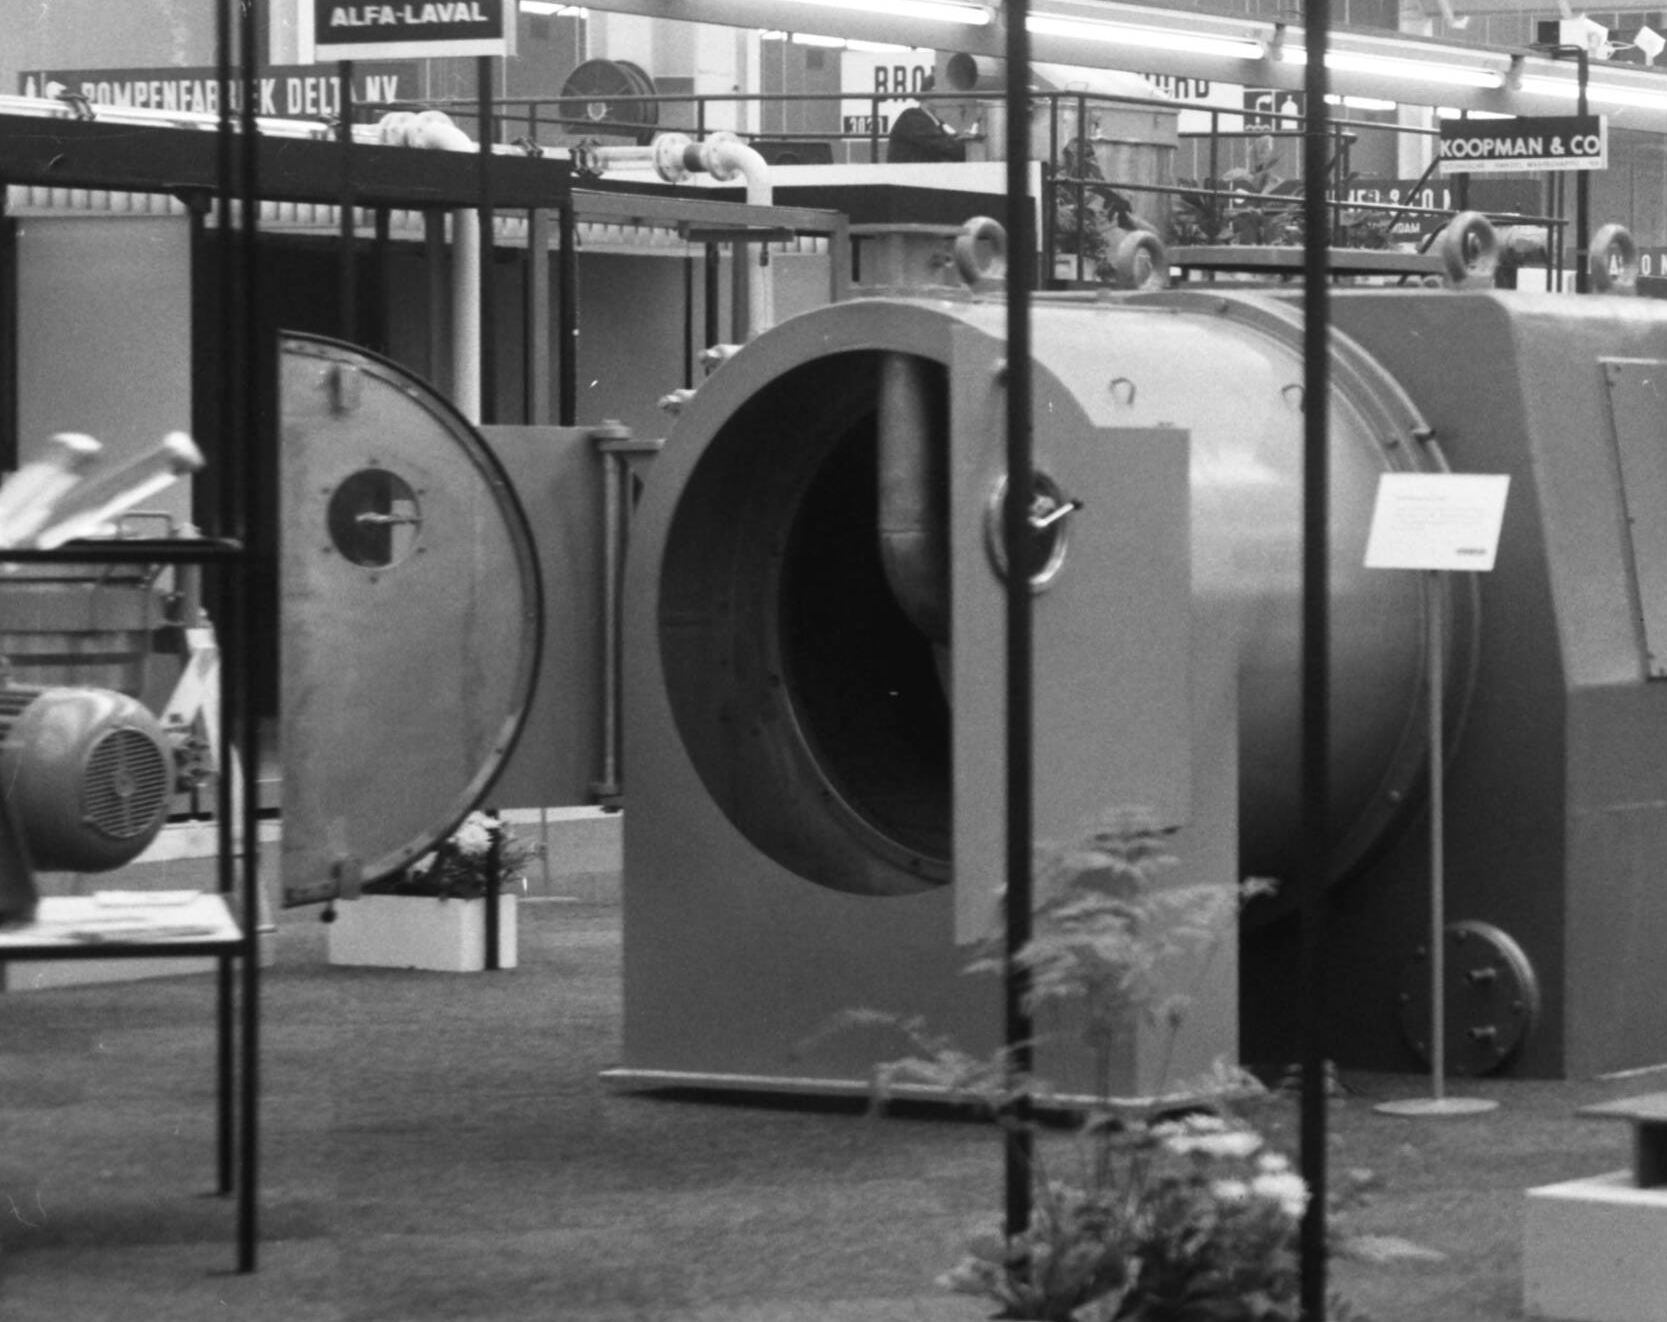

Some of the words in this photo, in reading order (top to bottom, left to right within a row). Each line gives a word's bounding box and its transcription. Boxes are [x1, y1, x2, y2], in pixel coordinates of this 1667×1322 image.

[330, 0, 489, 28] ALFA-LAVAL
[286, 76, 356, 116] DELT
[1440, 136, 1544, 158] KOOPMAN
[1550, 136, 1565, 155] &
[1570, 134, 1600, 155] CO
